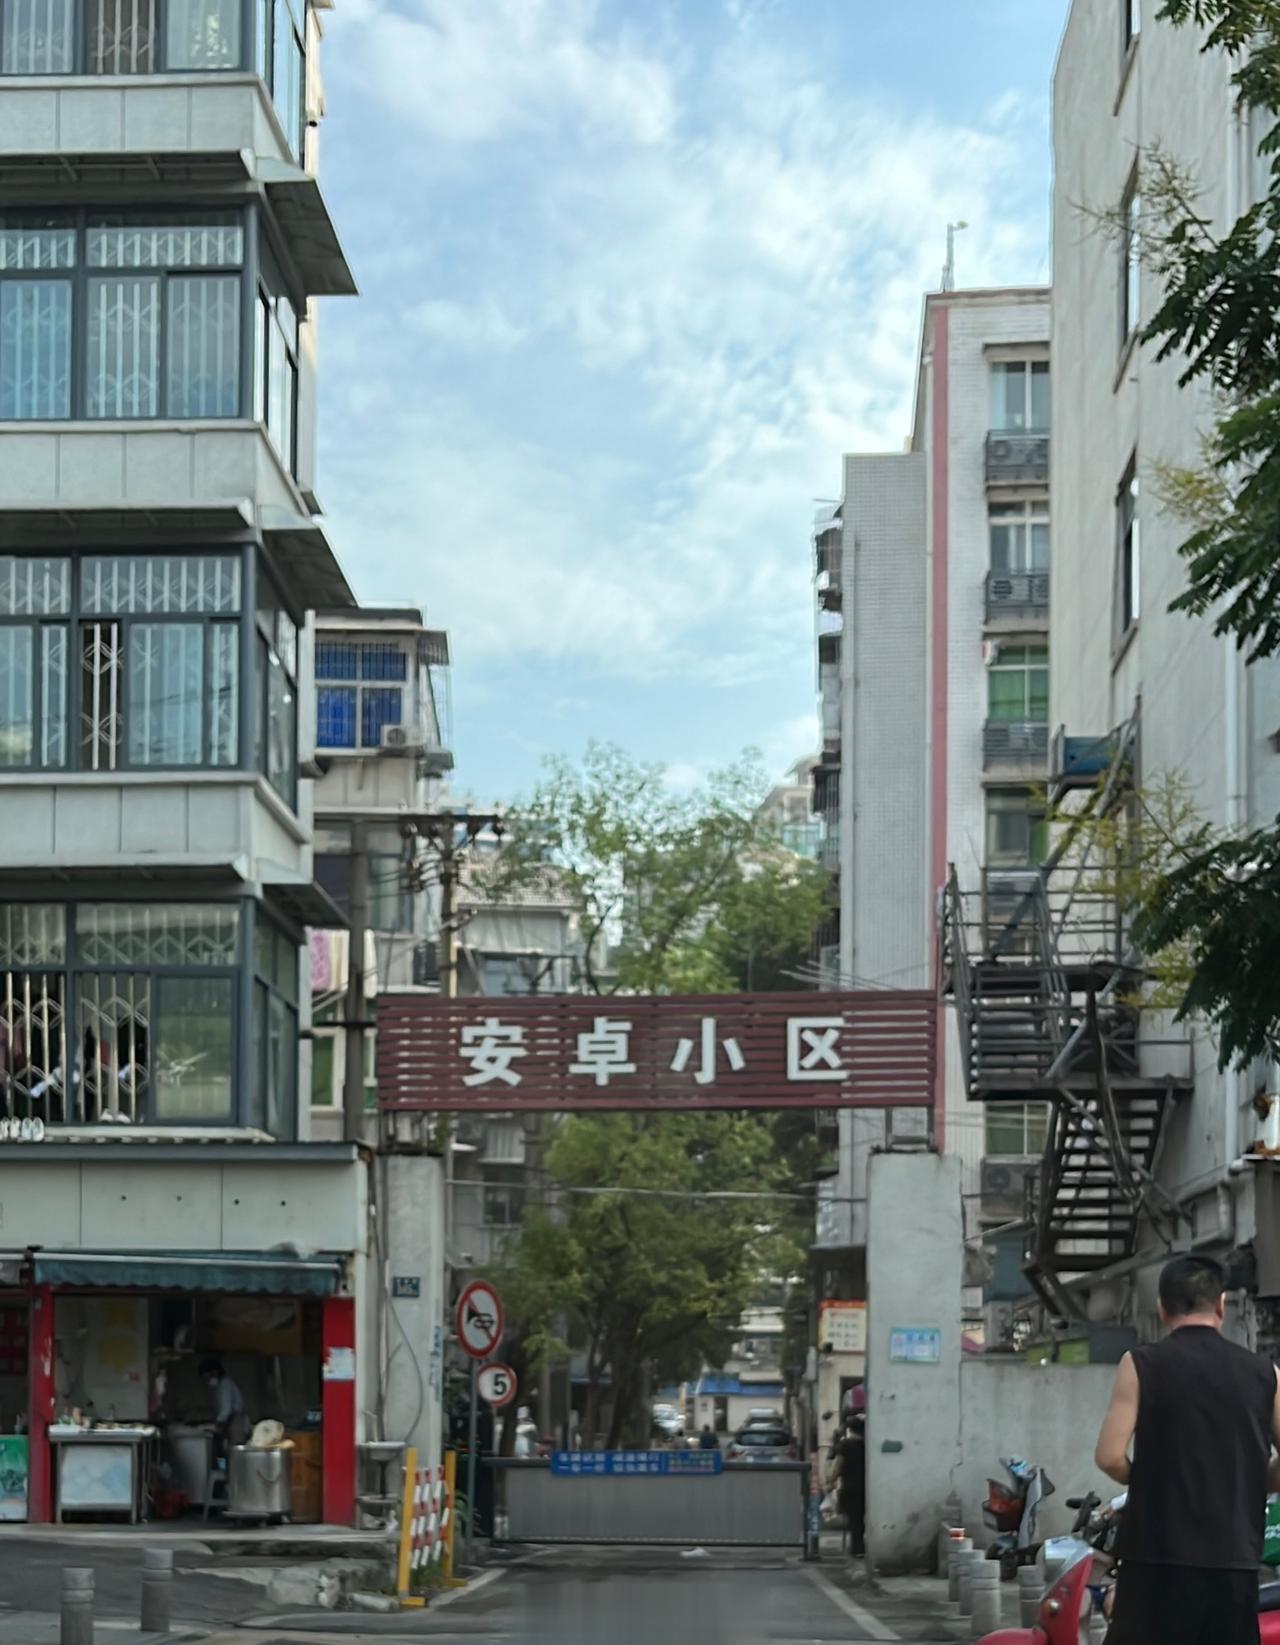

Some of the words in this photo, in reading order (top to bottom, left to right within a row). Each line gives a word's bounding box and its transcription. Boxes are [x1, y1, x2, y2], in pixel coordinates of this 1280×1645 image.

[459, 1016, 849, 1086] 安卓小区
[494, 1373, 508, 1396] 5
